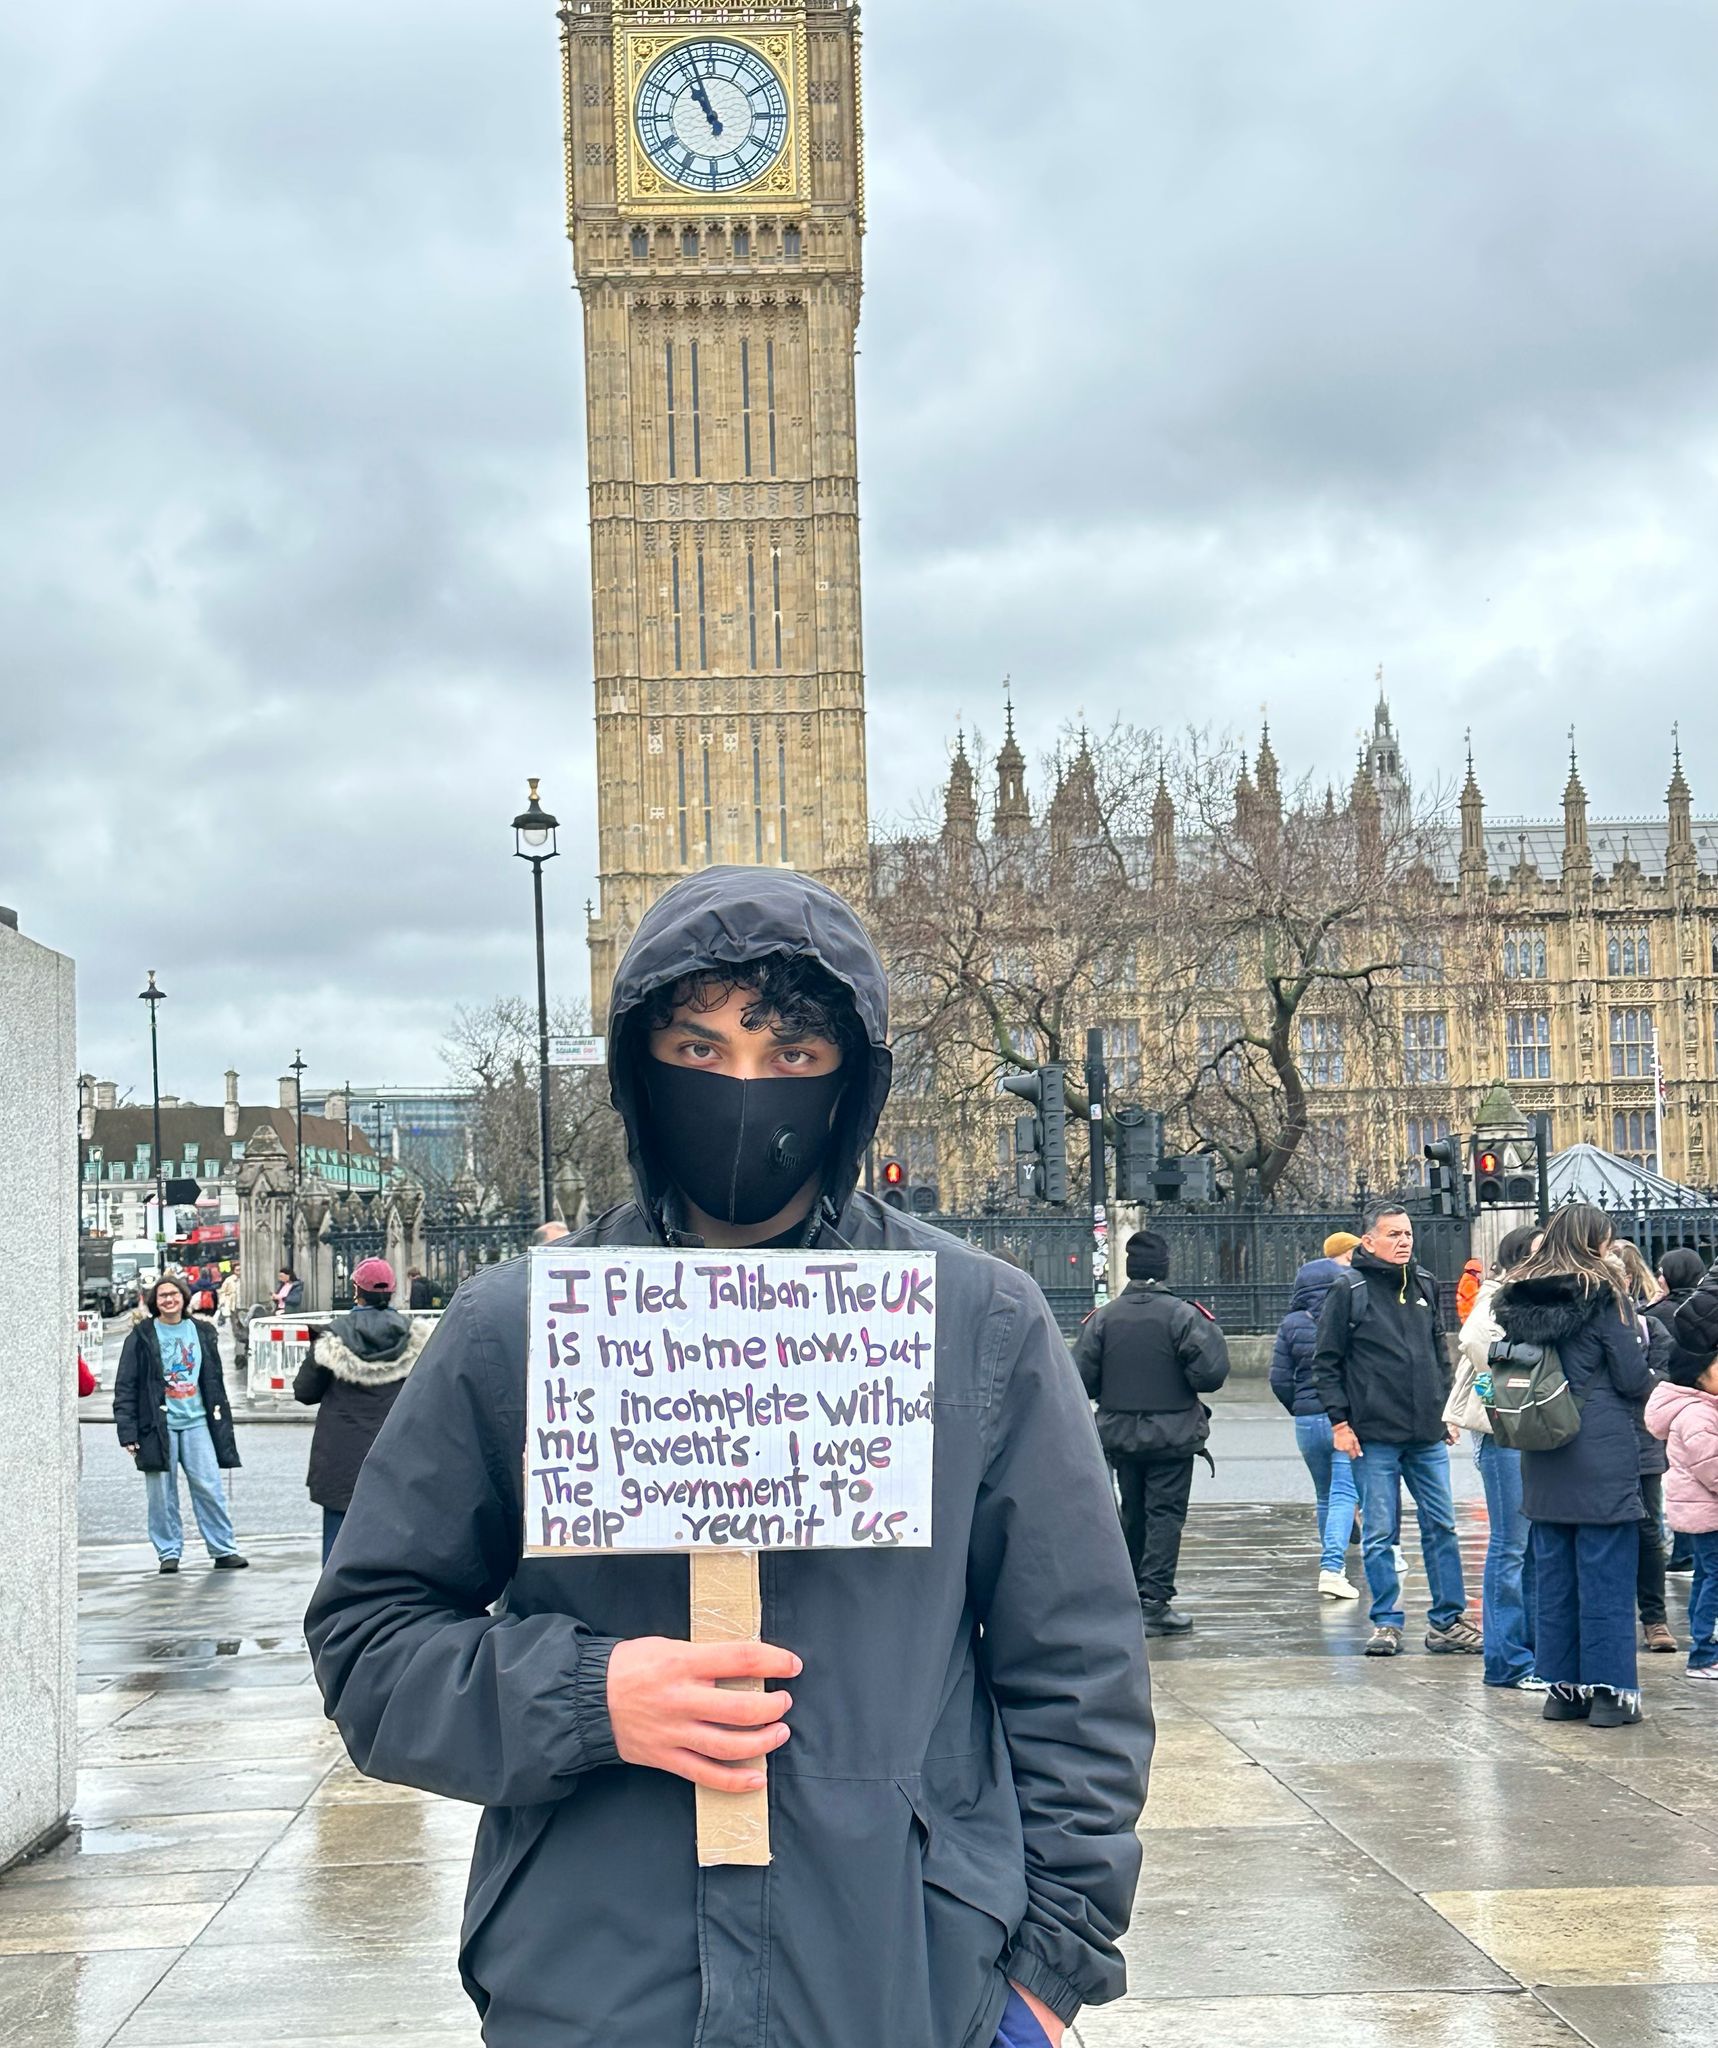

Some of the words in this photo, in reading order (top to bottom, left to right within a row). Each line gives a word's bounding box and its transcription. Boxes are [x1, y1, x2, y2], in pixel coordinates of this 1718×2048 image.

[549, 1270, 590, 1314] I
[806, 1263, 875, 1315] The
[882, 1267, 934, 1315] UK
[546, 1319, 580, 1369] is
[597, 1334, 653, 1377] my
[663, 1328, 766, 1372] home
[776, 1331, 856, 1367] now,
[860, 1328, 931, 1369] but
[545, 1378, 595, 1424] It's
[620, 1384, 808, 1429] incomplete
[537, 1428, 598, 1471] my
[789, 1431, 799, 1466] I
[813, 1435, 892, 1474] urge
[532, 1467, 594, 1506] The
[621, 1467, 809, 1516] government
[819, 1471, 873, 1516] to
[682, 1504, 825, 1546] reunit
[851, 1510, 918, 1545] us.
